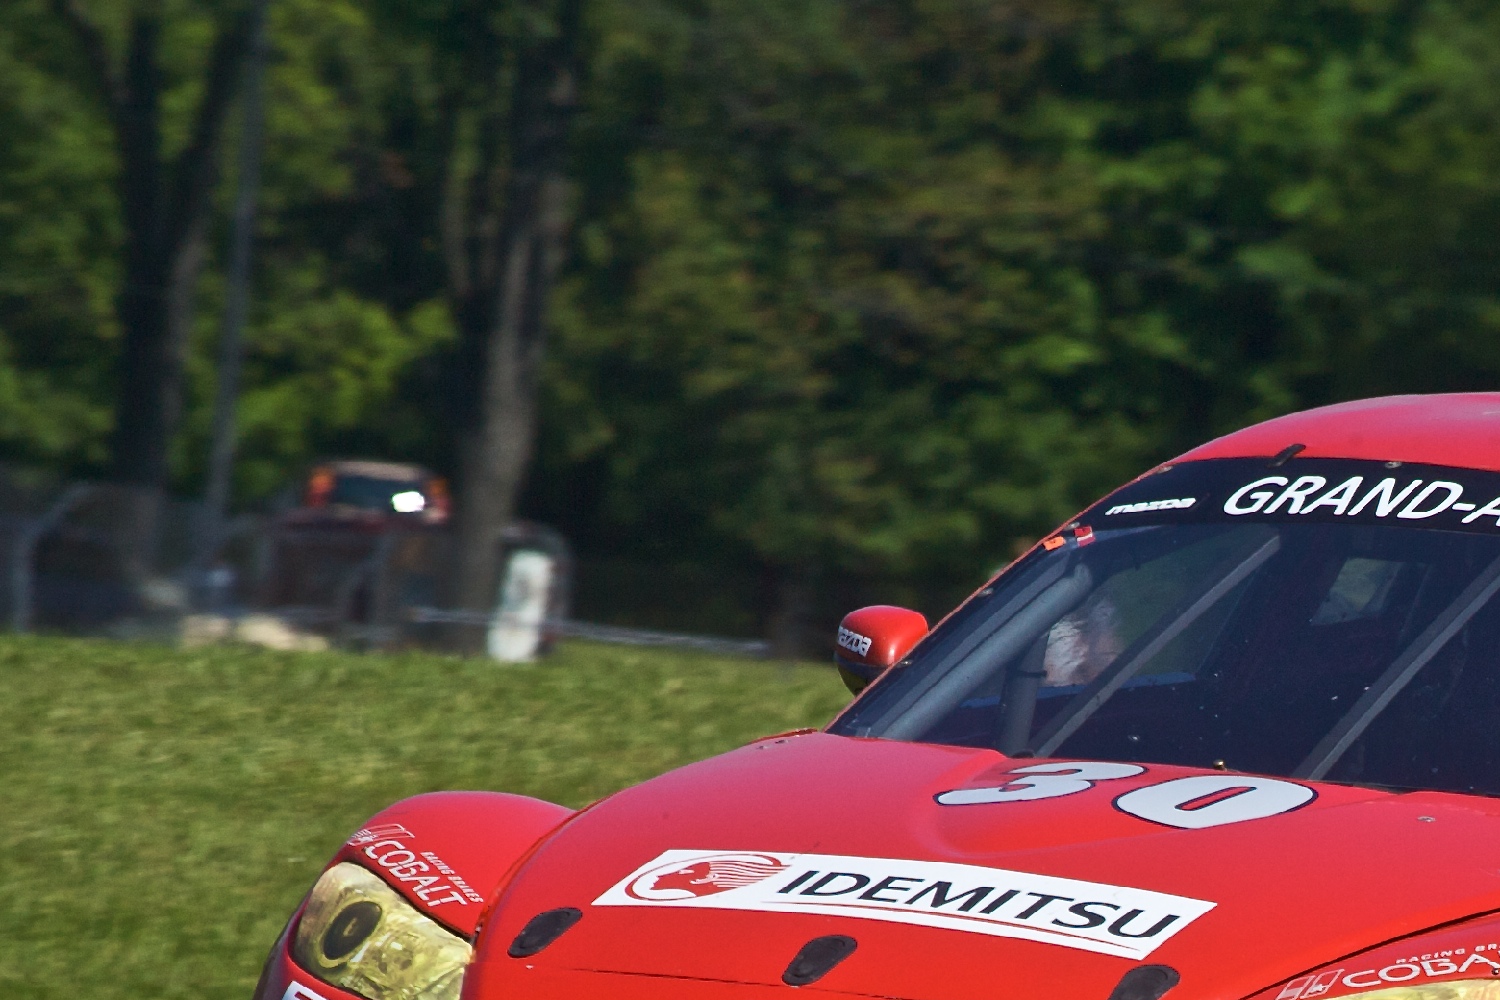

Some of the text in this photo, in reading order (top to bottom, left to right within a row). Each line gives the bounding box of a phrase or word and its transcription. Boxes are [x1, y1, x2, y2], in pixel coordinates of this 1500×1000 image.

[1105, 498, 1196, 515] mazda
[932, 761, 1319, 830] 30
[364, 840, 468, 907] COBALT
[778, 869, 1182, 940] IDEMITSU
[1395, 947, 1466, 964] RACING
